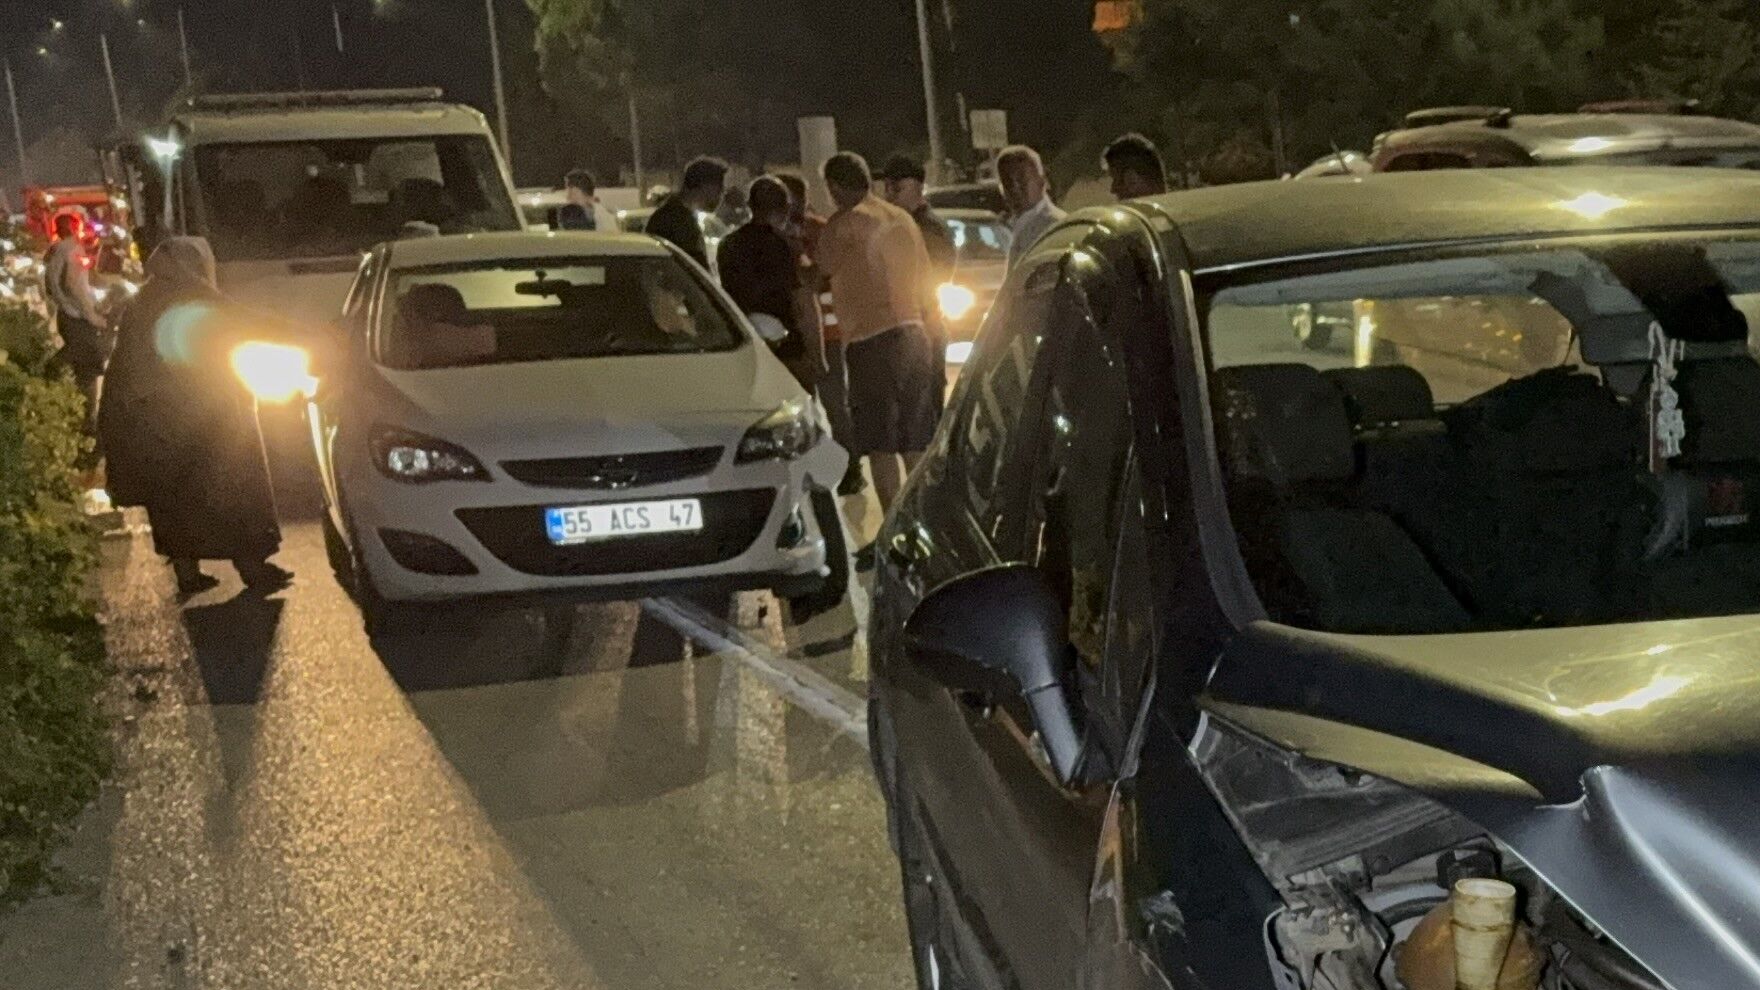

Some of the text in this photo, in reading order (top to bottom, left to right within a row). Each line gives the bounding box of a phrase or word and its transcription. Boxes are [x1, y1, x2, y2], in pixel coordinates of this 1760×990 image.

[564, 503, 693, 534] 55 ACS 47
